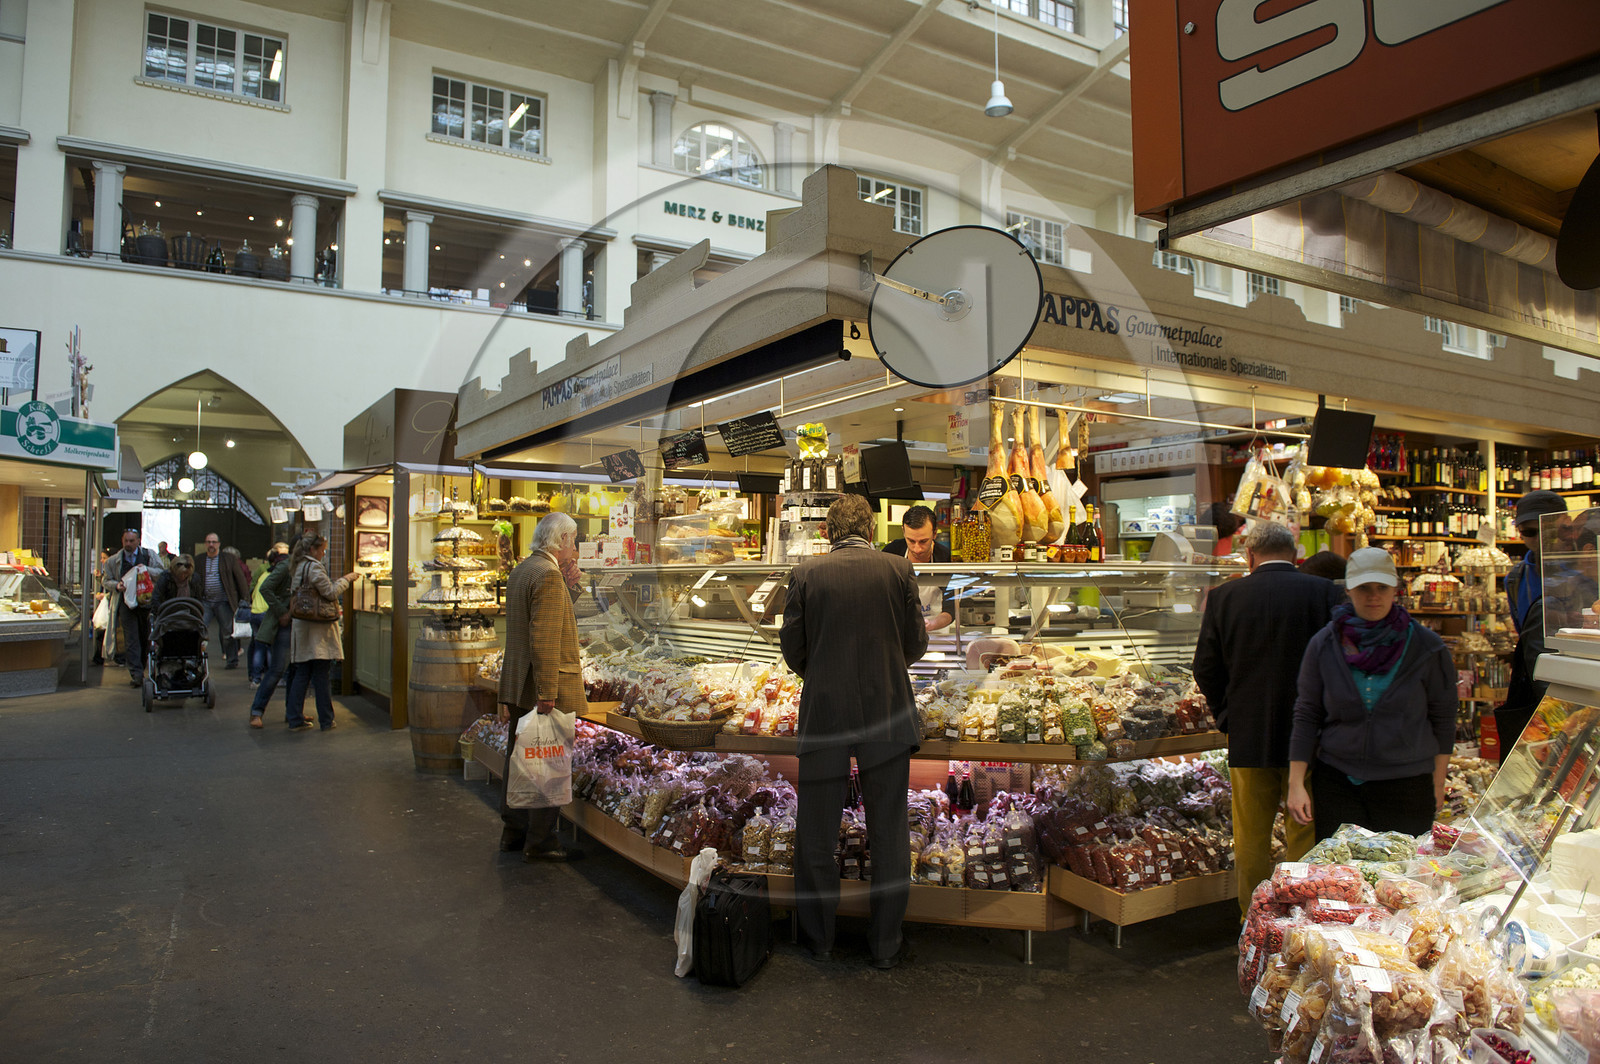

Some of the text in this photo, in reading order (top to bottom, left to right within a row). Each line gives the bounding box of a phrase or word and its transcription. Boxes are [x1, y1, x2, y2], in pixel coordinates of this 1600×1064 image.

[664, 201, 765, 232] MERZ & BENZ
[1042, 293, 1222, 349] APPAS Gourmetpalace
[1156, 346, 1287, 382] Internationale Spezialitäten
[28, 402, 50, 413] Käse
[64, 447, 110, 459] Molkereiprodukte
